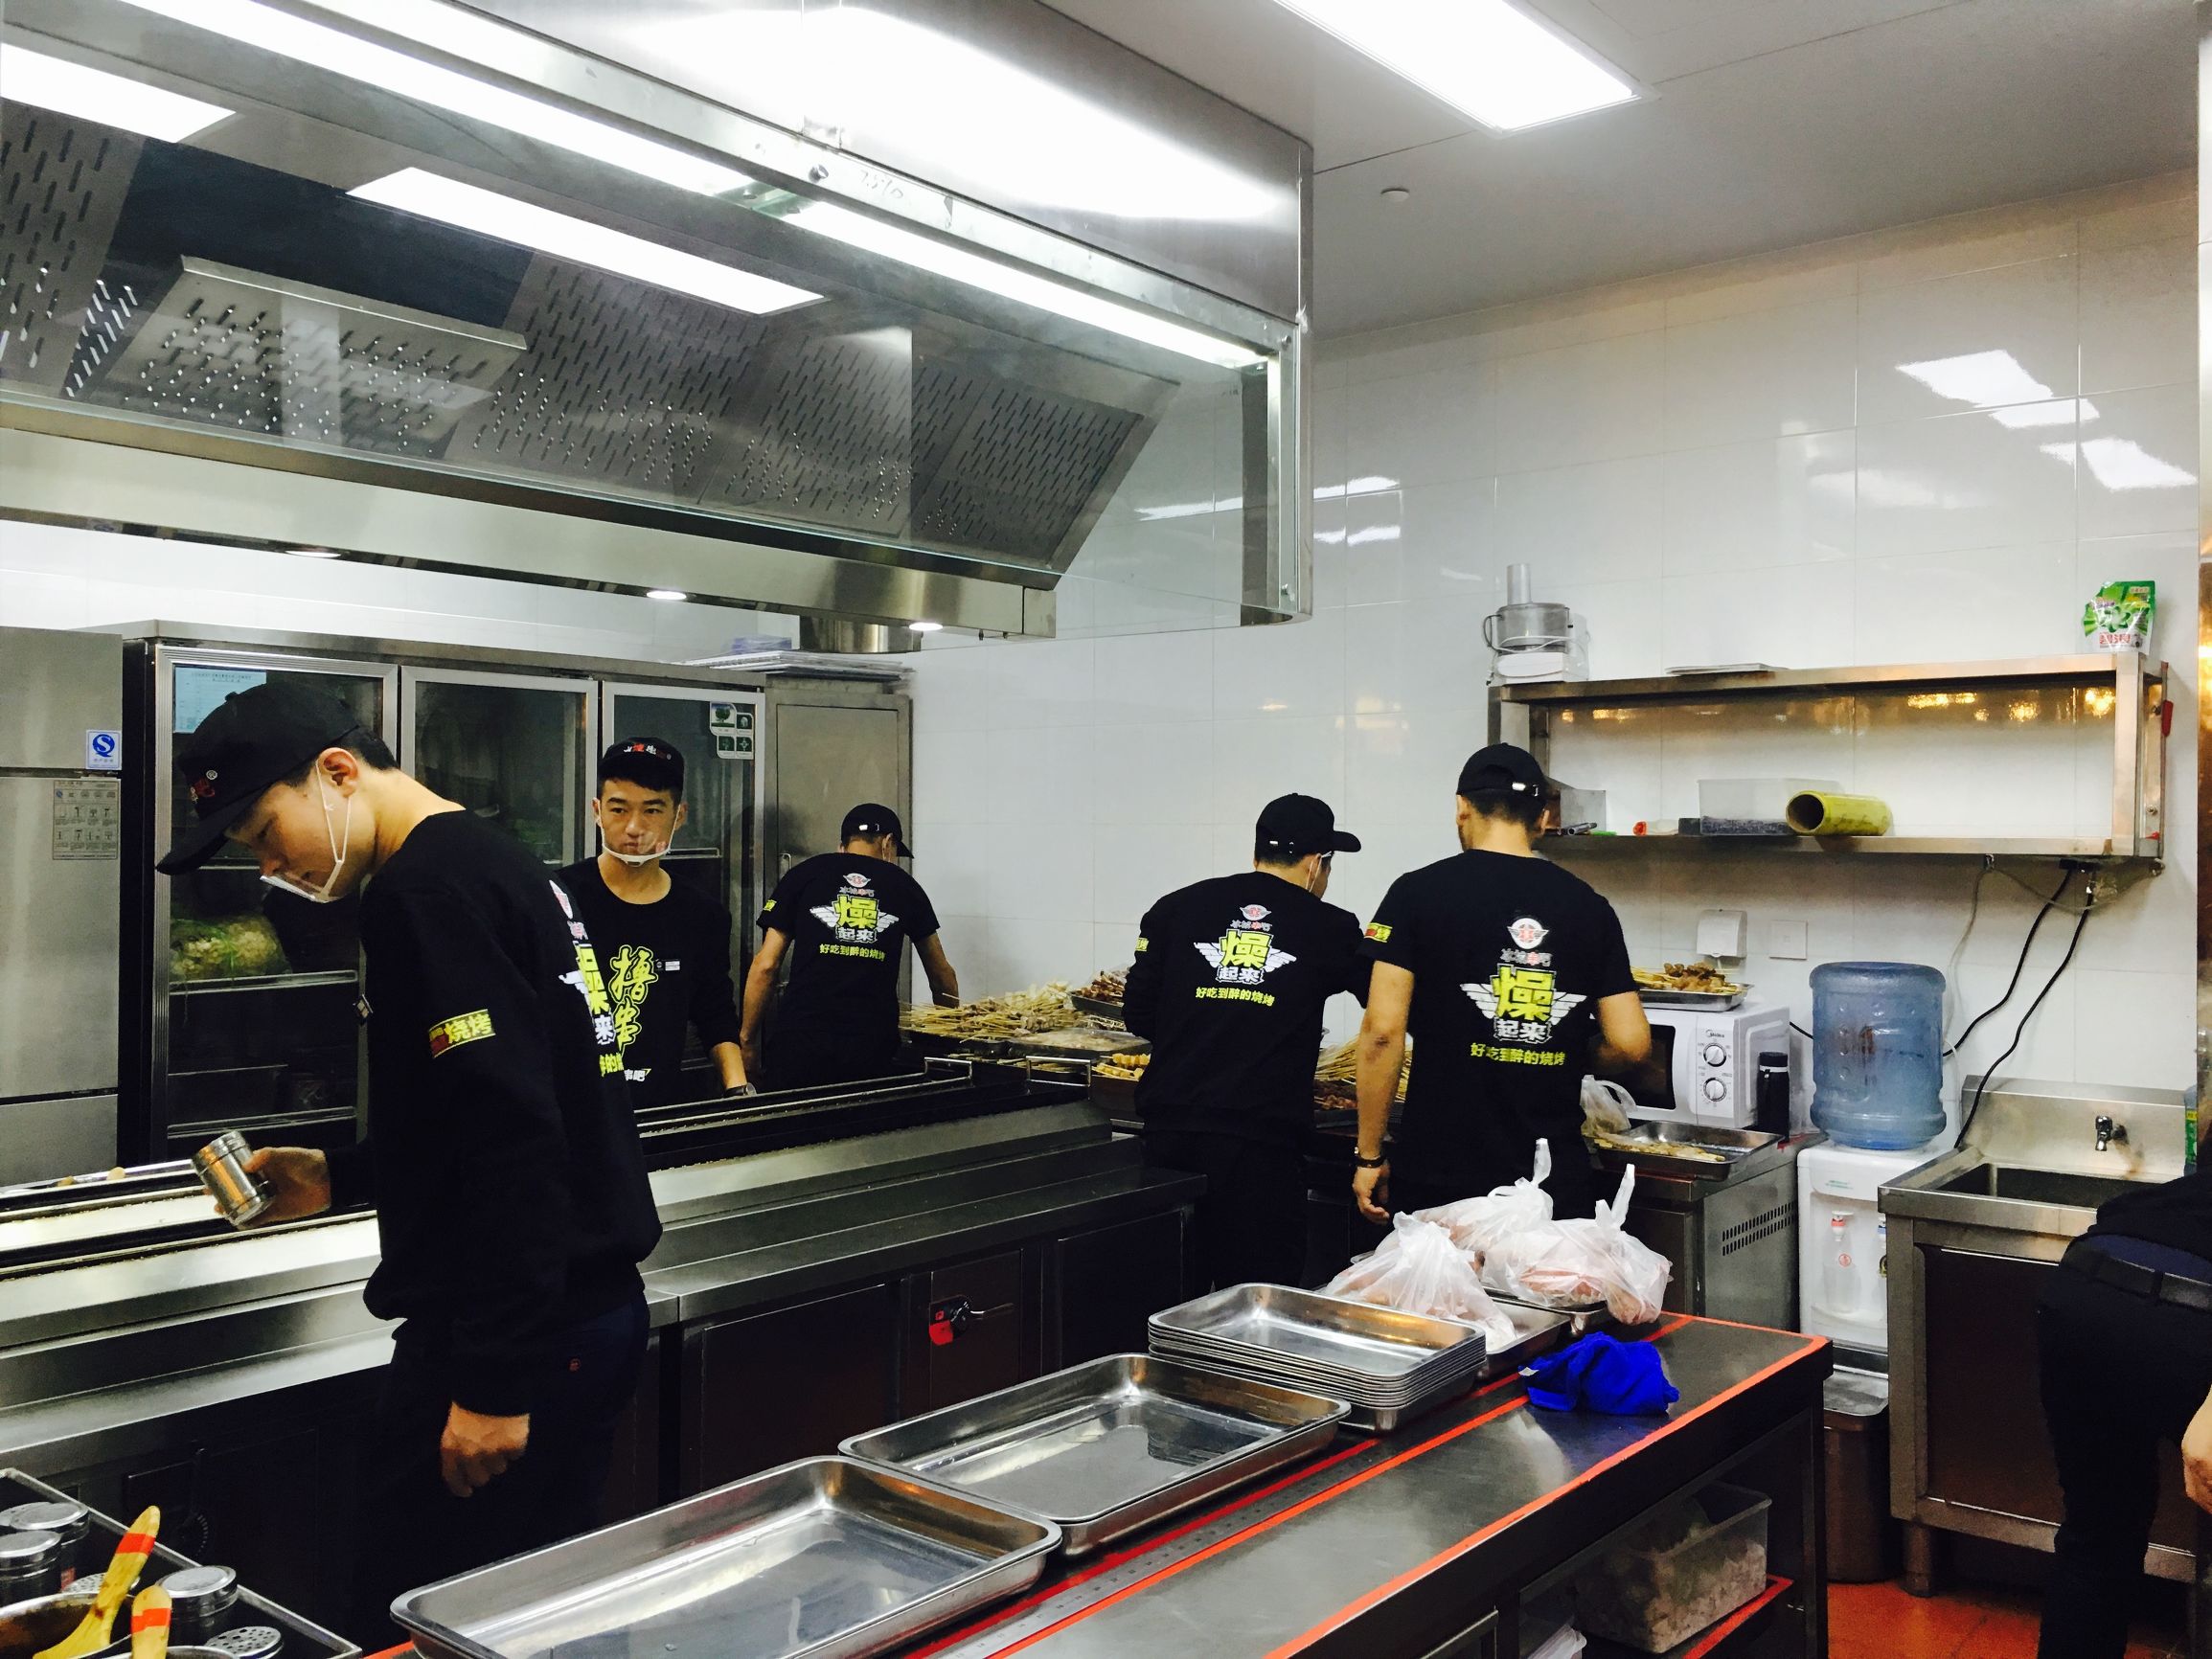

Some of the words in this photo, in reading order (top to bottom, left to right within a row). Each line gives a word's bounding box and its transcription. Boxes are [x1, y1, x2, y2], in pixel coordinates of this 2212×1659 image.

[832, 895, 879, 929] 燥
[837, 927, 875, 942] 起来
[1220, 929, 1272, 969] 燥
[1218, 966, 1262, 983] 起来
[1195, 987, 1276, 1008] 好吃到醉的烧烤
[1491, 965, 1556, 1022] 燥
[1495, 1018, 1549, 1041] 起来
[1470, 1042, 1566, 1066] 好吃到醉的烧烤
